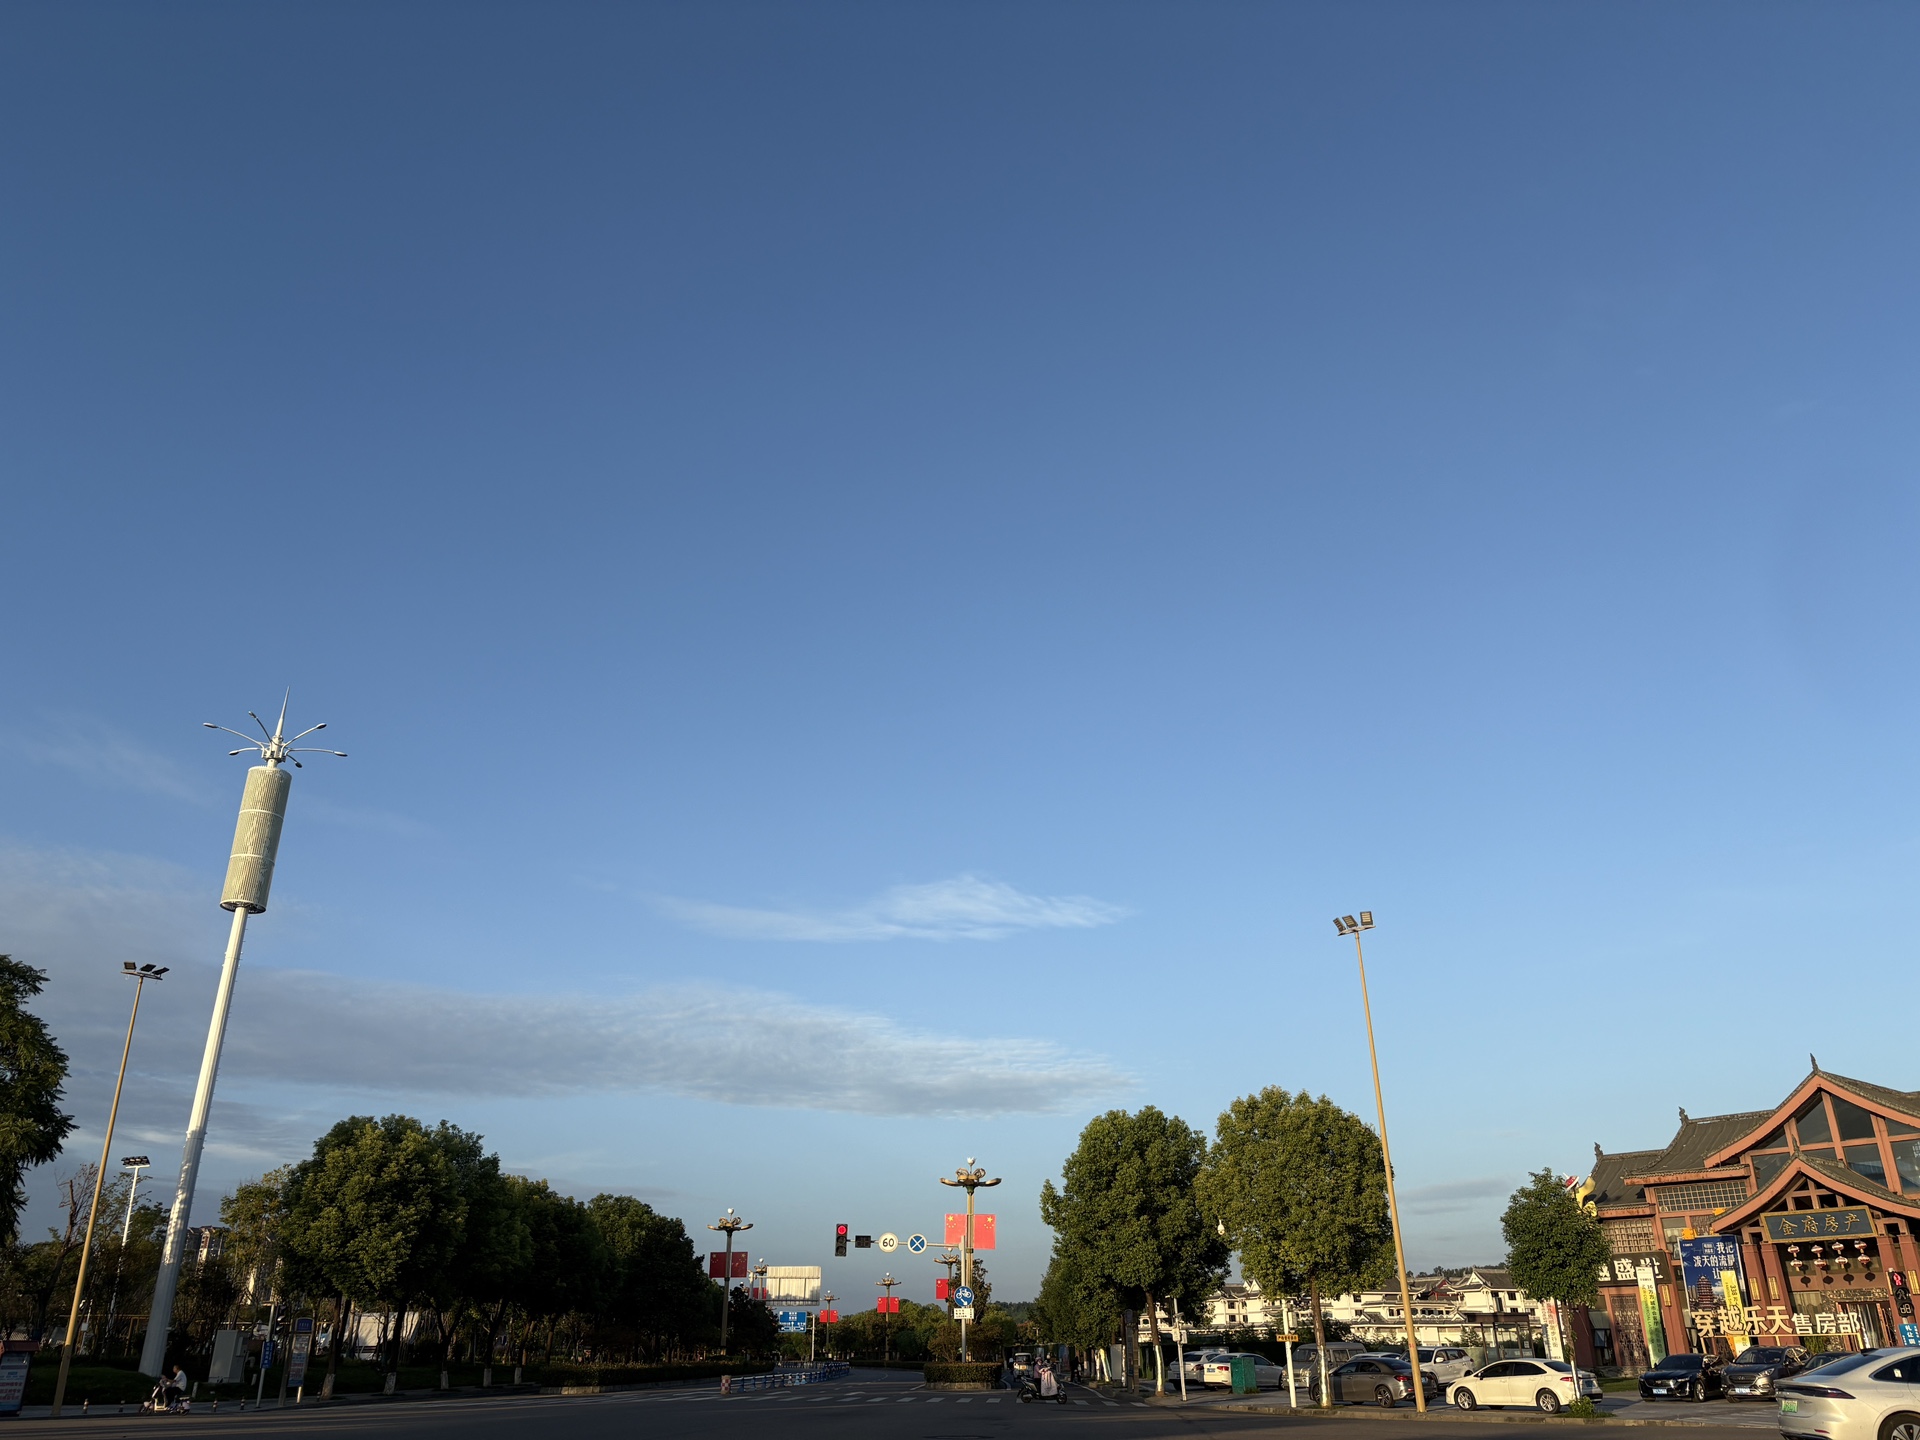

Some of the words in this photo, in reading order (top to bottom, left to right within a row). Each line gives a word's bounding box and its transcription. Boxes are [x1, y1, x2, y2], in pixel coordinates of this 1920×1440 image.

[1778, 1212, 1860, 1236] 金府房产
[882, 1237, 895, 1248] 60
[1690, 1304, 1861, 1338] 穿越乐天售房部
